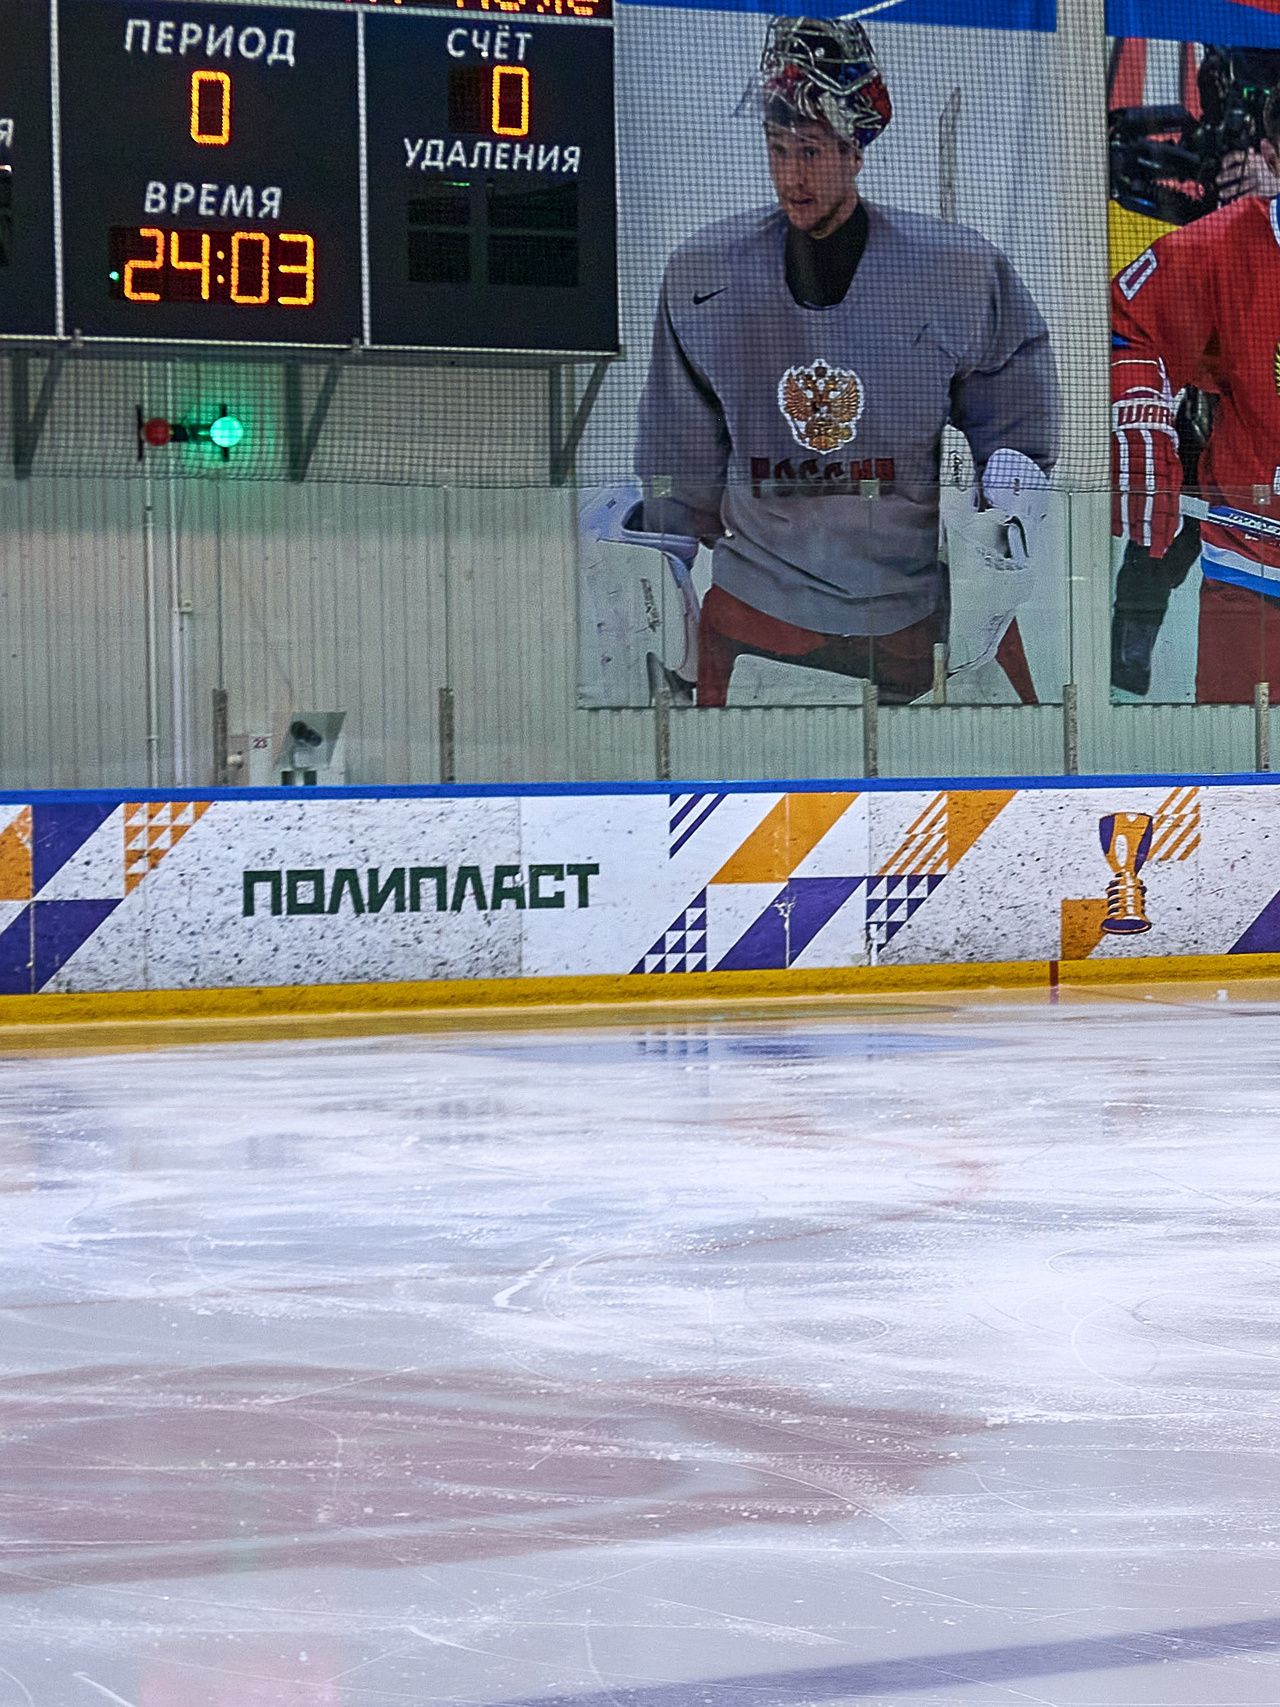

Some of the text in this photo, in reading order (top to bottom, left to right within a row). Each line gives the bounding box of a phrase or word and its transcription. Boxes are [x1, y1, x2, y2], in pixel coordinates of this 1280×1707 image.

[124, 19, 296, 66] ПЕРИОД
[447, 25, 533, 60] СЧЁТ
[190, 70, 231, 145] 0
[491, 65, 529, 136] 0
[404, 138, 581, 173] УДАЛЕНИЯ
[144, 181, 283, 219] ВРЕМЯ
[124, 228, 315, 306] 24:03
[242, 864, 600, 917] ПОЛИПЛАСТ
